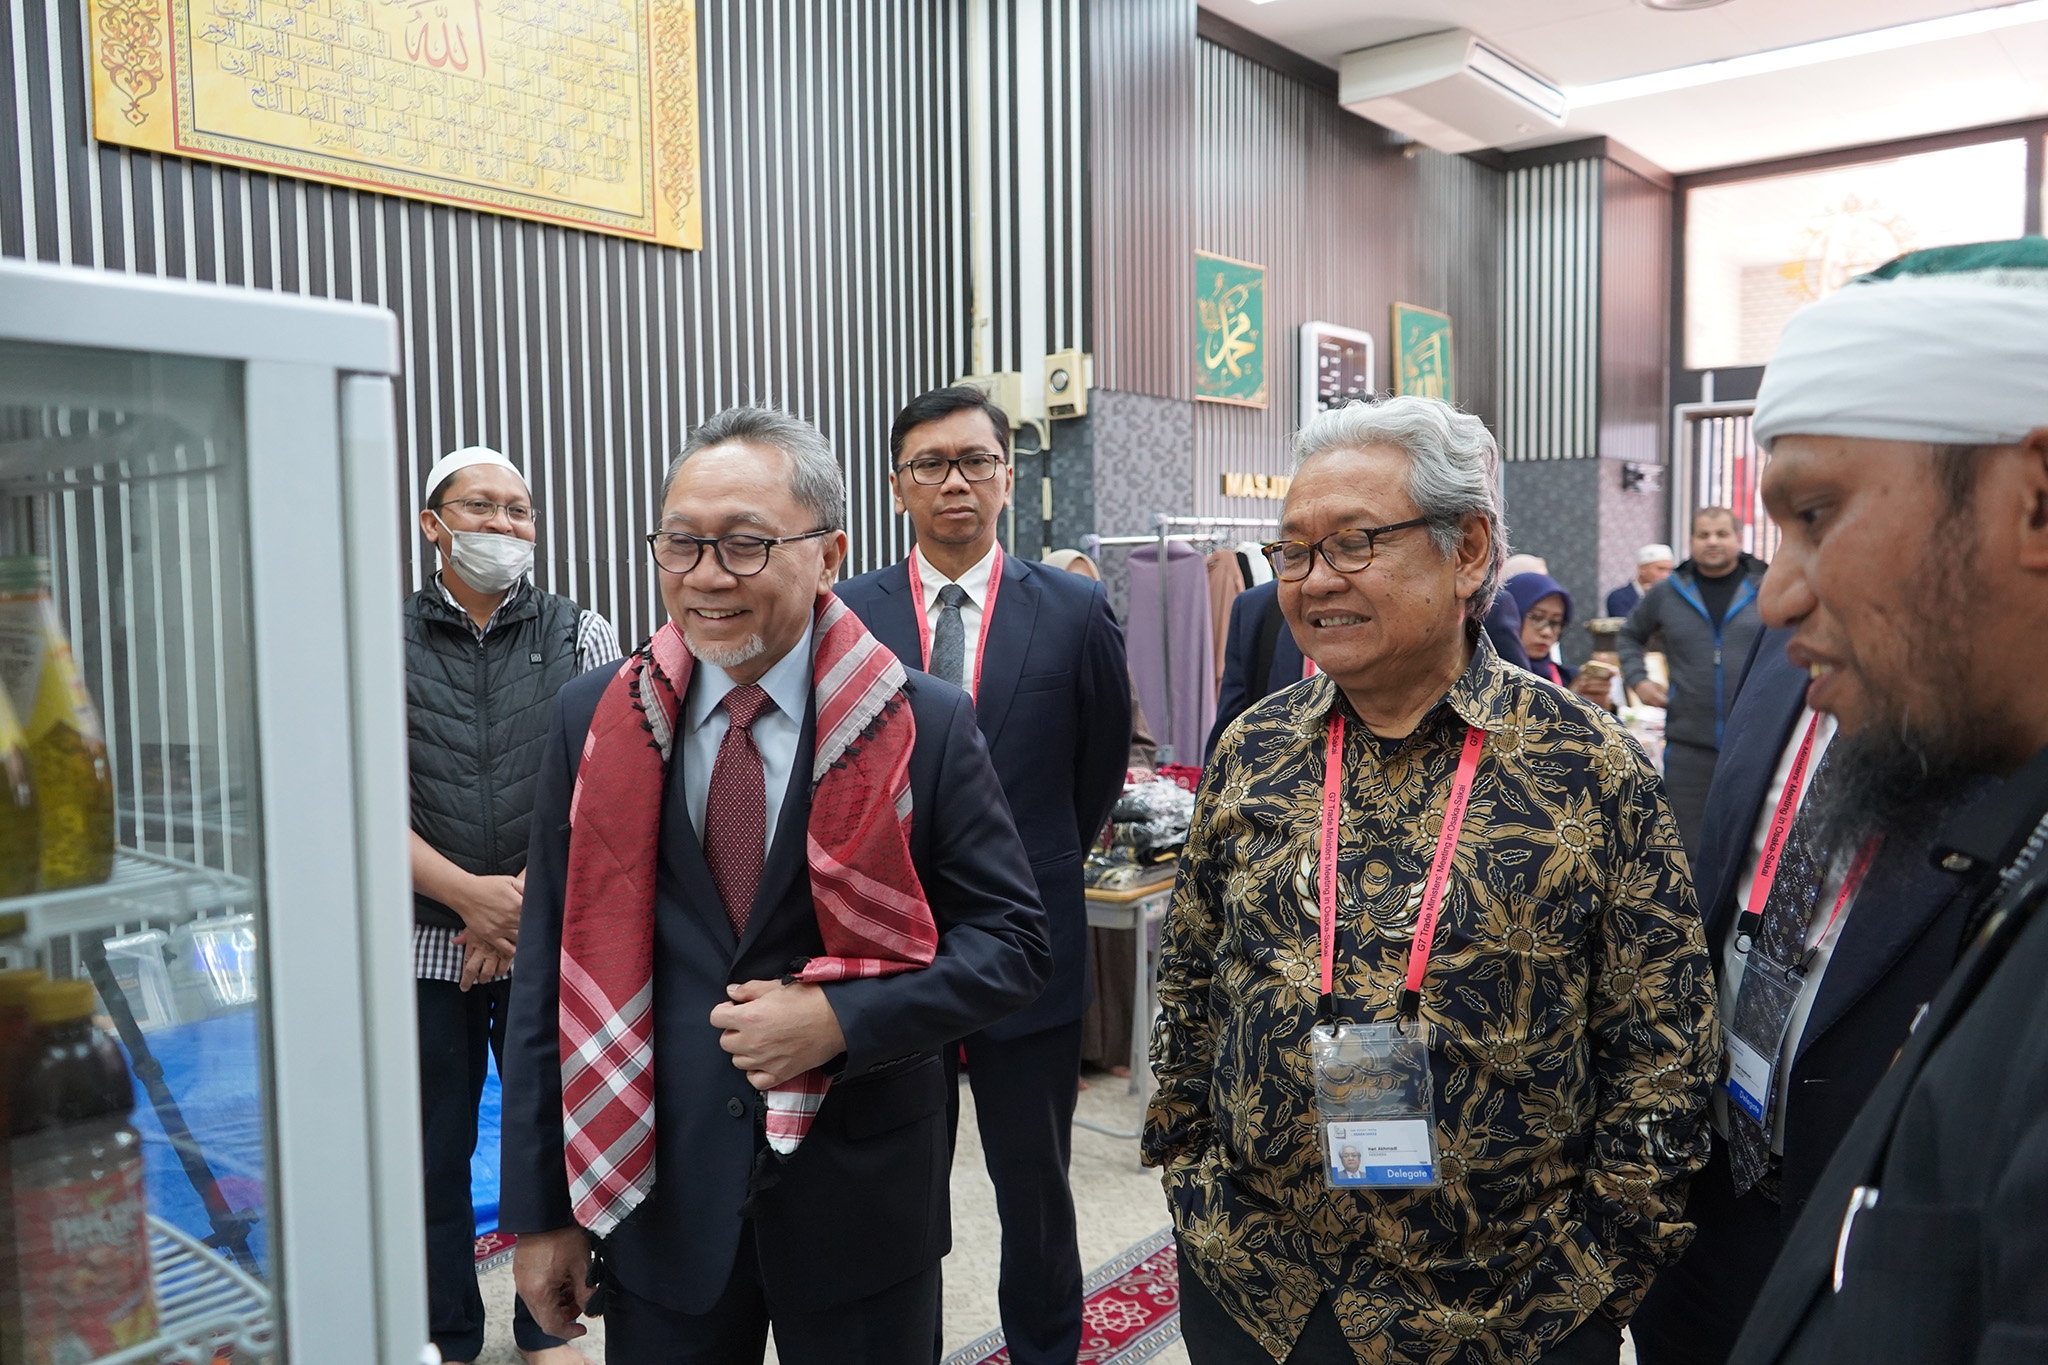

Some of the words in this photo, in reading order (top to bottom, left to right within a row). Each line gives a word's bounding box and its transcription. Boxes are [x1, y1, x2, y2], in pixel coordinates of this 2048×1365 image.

[1331, 718, 1341, 756] saka-Sakai
[1470, 734, 1479, 747] G7
[1328, 791, 1338, 804] G7
[1779, 783, 1798, 816] Meeting
[1326, 805, 1336, 826] Trade
[1445, 784, 1467, 833] Osaka-Sakai
[1777, 816, 1788, 825] in
[1444, 833, 1453, 842] in
[1437, 842, 1453, 873] Meeting
[1760, 825, 1785, 878] Osaka-Sakai
[1322, 863, 1333, 896] Meeting
[1323, 896, 1332, 905] in
[1322, 906, 1333, 958] Osaka-Sakai
[1420, 915, 1431, 936] Trade
[1417, 938, 1427, 953] G7
[1387, 1168, 1428, 1180] Delegate
